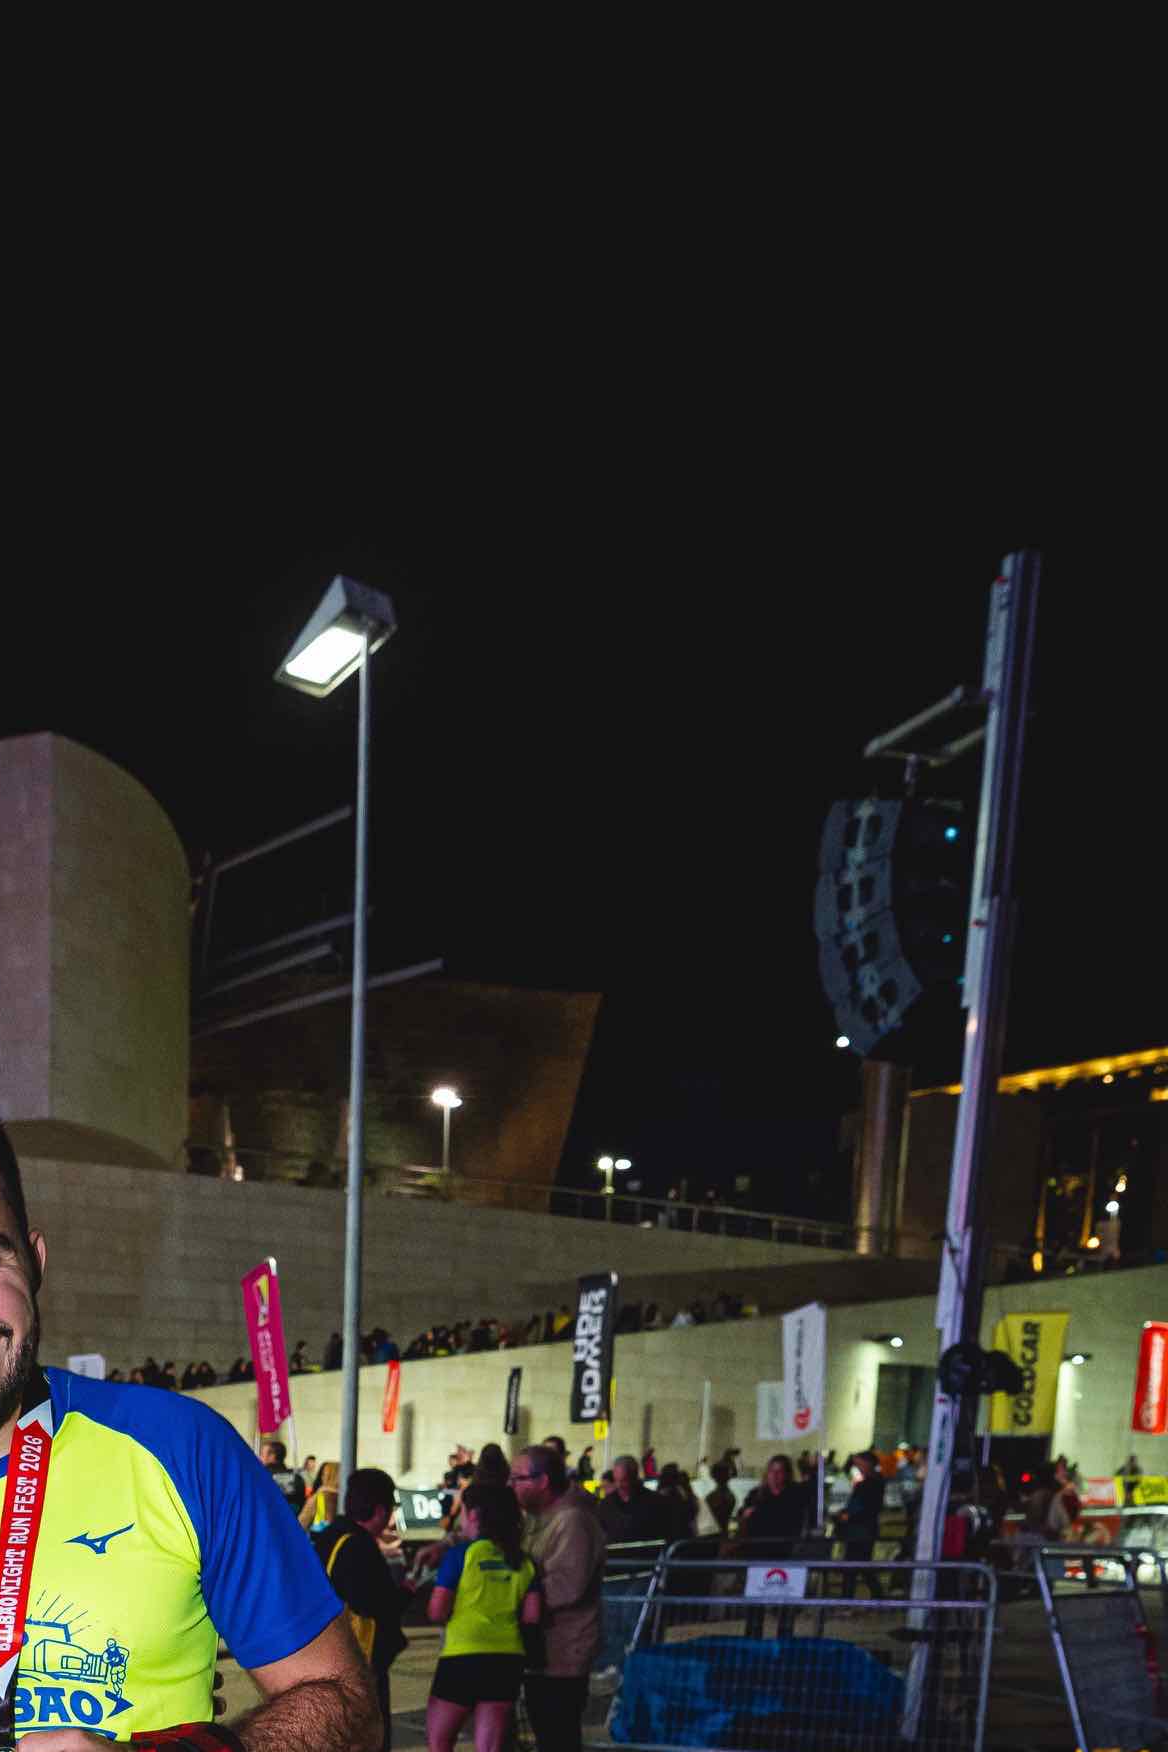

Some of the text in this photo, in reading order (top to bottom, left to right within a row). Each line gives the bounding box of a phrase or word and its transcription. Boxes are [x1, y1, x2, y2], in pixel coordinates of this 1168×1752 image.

[20, 1434, 43, 1472] 2026
[13, 1475, 37, 1514] FEST
[8, 1516, 32, 1545] RUN
